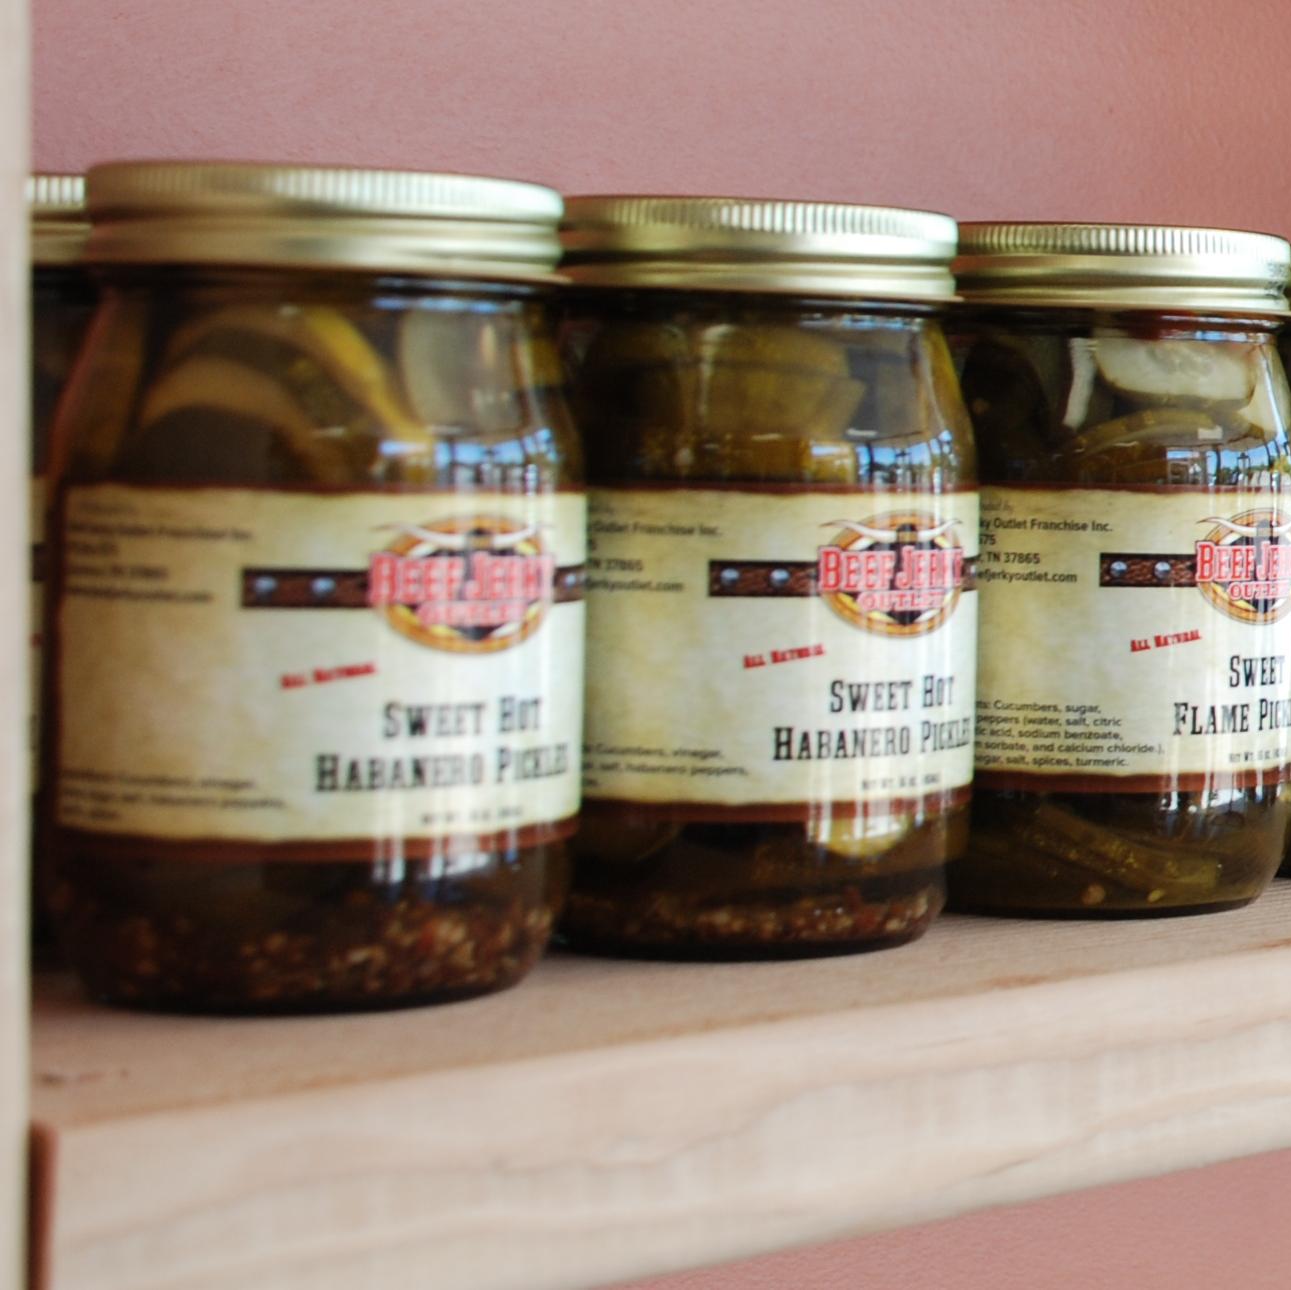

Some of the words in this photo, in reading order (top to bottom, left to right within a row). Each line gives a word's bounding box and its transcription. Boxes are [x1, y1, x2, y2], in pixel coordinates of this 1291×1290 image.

[993, 517, 1027, 530] Outlet
[1030, 518, 1088, 532] Franchise
[1091, 520, 1113, 532] Inc.
[819, 548, 896, 592] BEEF
[895, 545, 965, 589] JERY
[986, 551, 1001, 562] TN
[1003, 552, 1041, 564] 37865
[1198, 542, 1257, 581] BEEF
[1229, 655, 1285, 688] SWEET
[829, 679, 912, 714] SWEET
[922, 674, 955, 708] HOT
[1065, 703, 1102, 715] sugar,
[383, 701, 486, 739] SWEET
[498, 695, 542, 734] HOT
[1172, 702, 1250, 735] FLAME
[772, 725, 912, 761] HABANERO
[314, 752, 486, 793] HABANERO
